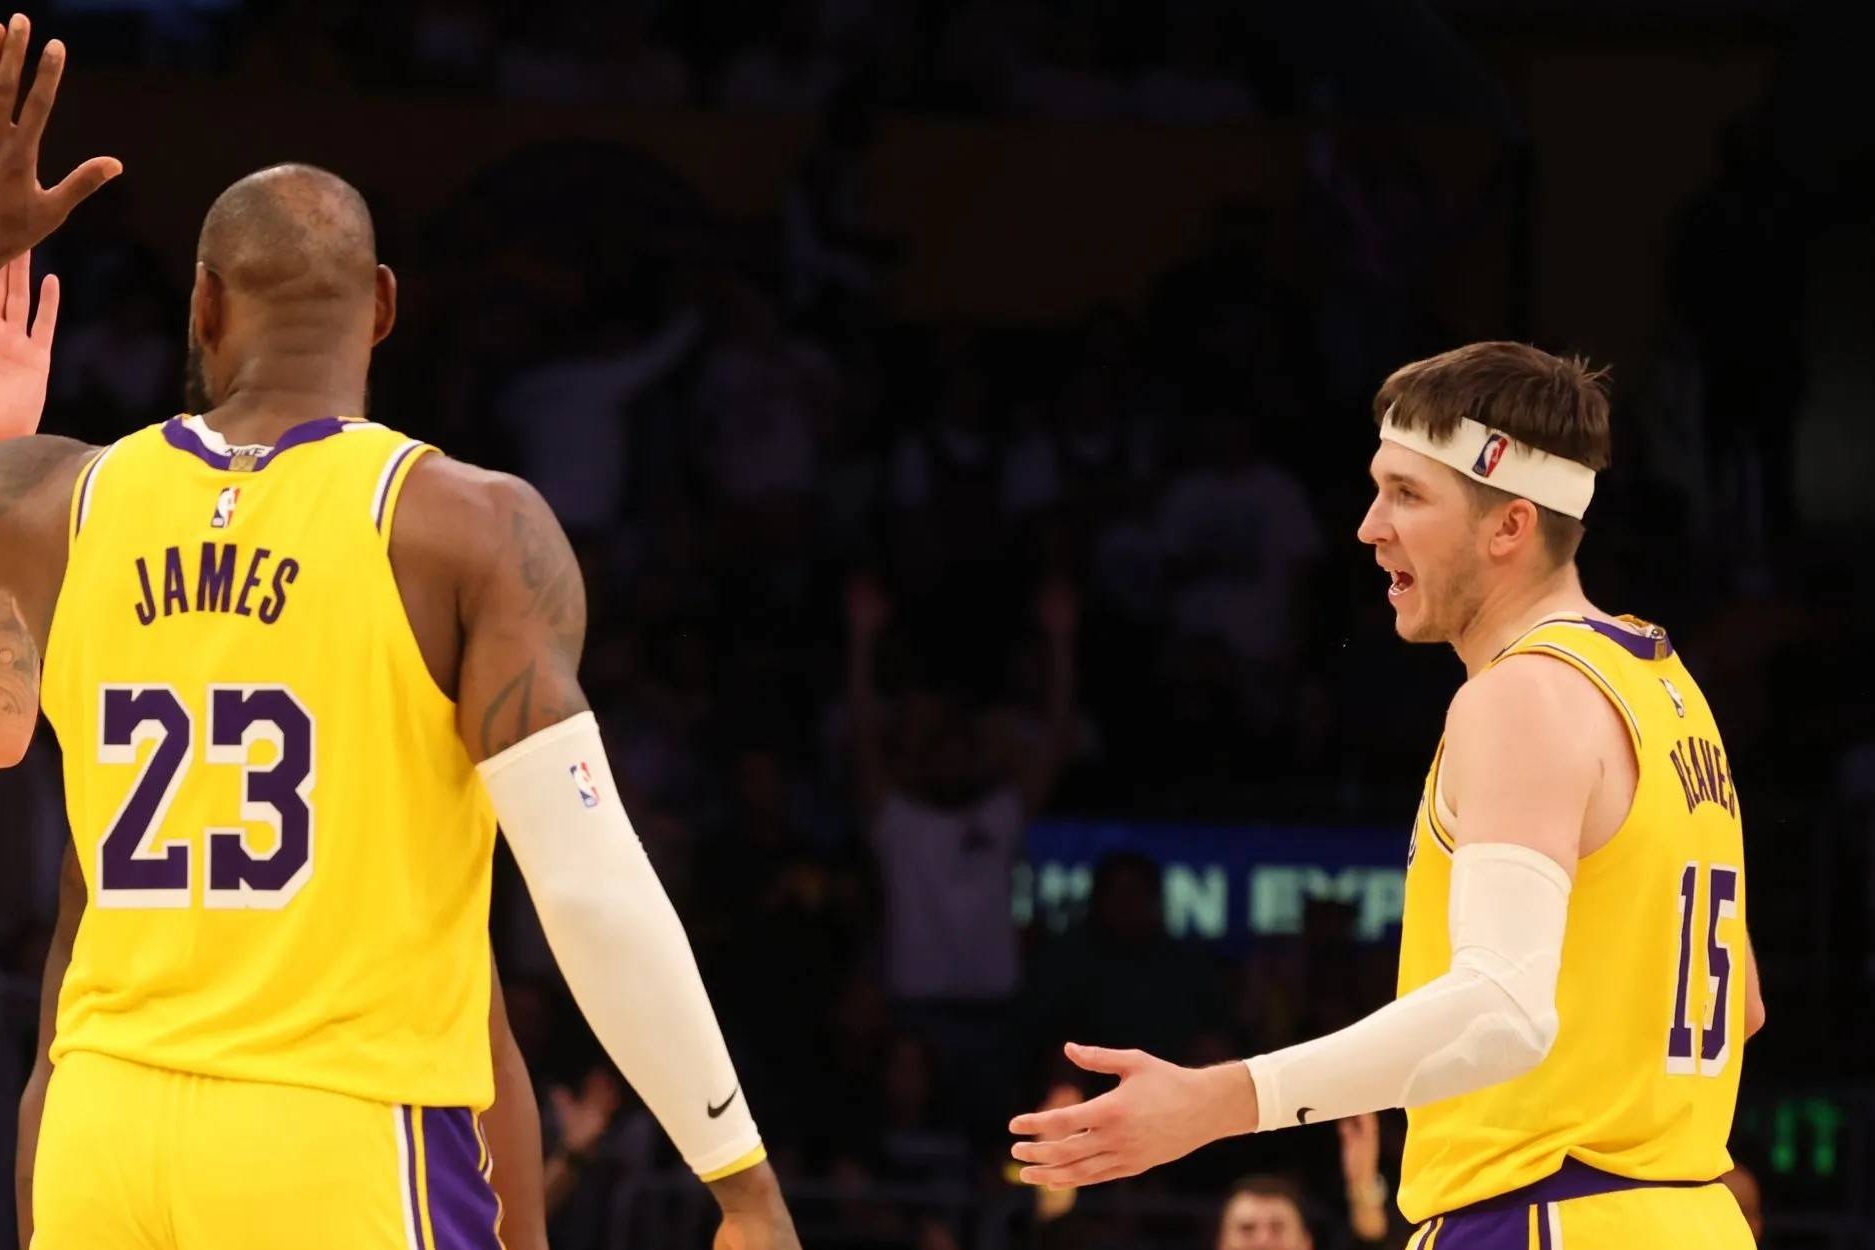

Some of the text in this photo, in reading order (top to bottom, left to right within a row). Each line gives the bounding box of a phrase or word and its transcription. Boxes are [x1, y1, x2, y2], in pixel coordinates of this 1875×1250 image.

[134, 541, 300, 626] JAMES
[96, 682, 318, 910] 23
[1665, 860, 1738, 1078] 15
